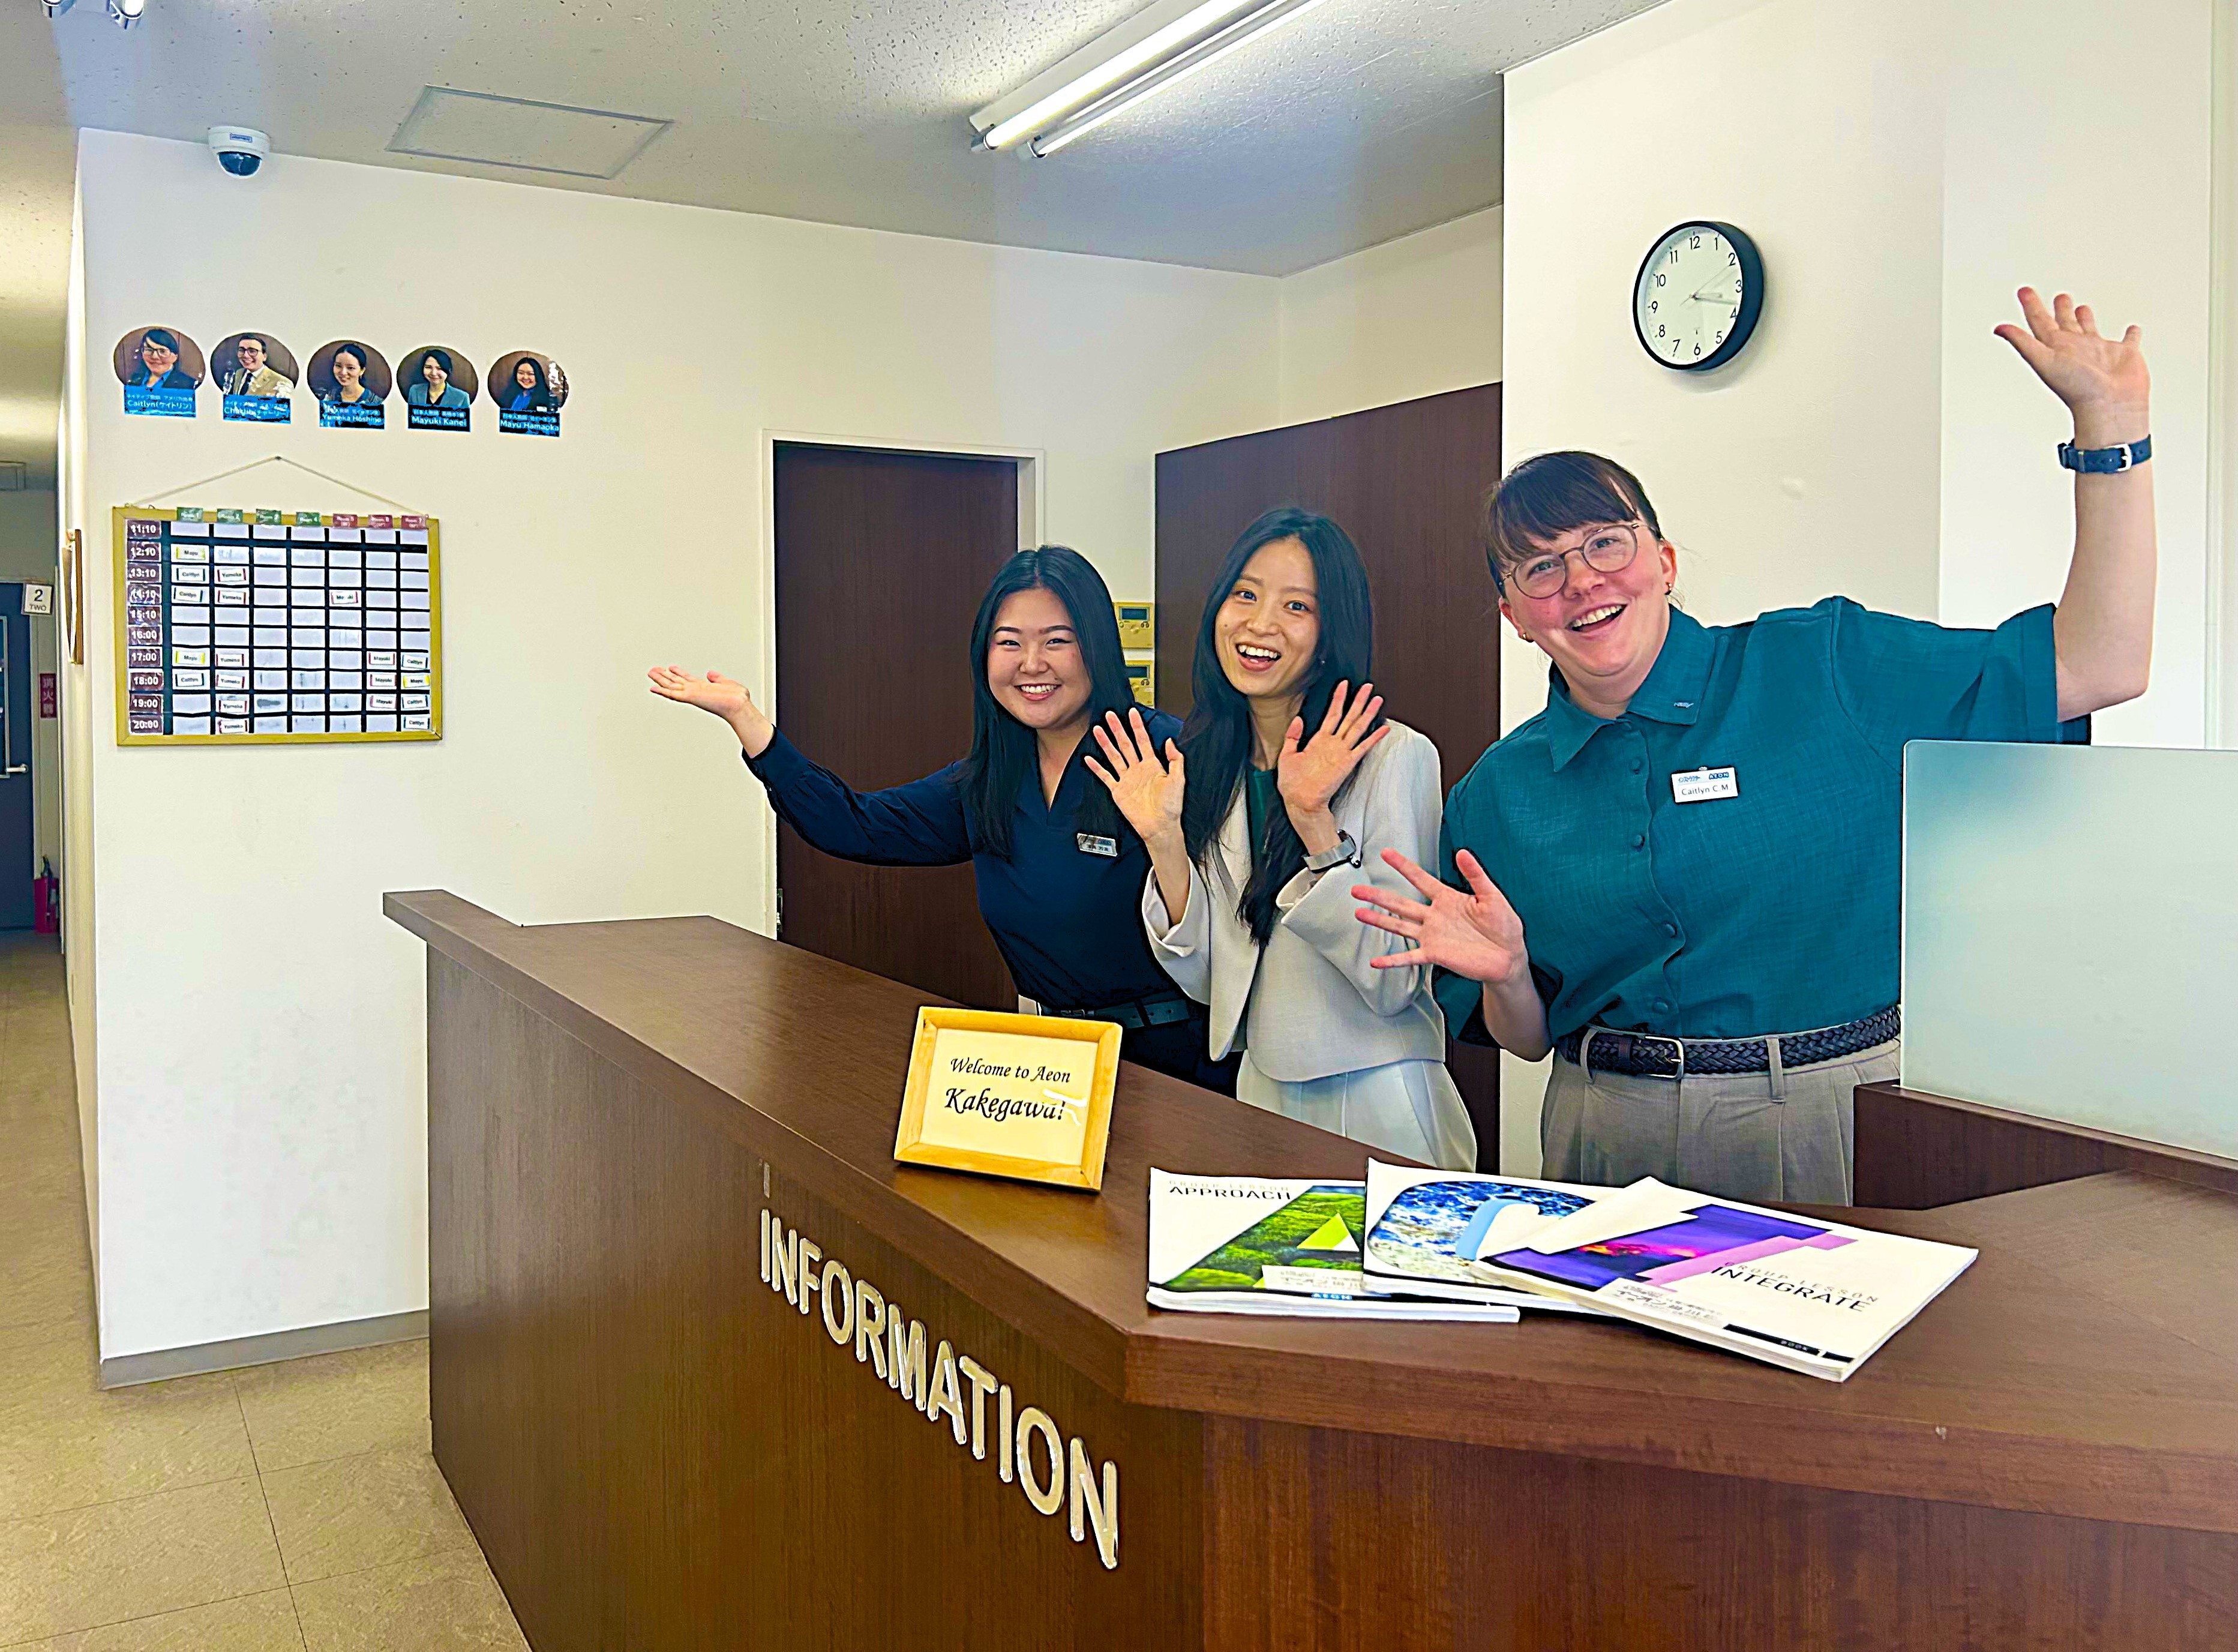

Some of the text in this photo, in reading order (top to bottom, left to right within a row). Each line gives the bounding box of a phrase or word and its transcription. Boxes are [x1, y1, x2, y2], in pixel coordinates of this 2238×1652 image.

[1689, 236, 1700, 250] 12
[1714, 237, 1718, 251] 1
[1670, 250, 1678, 264] 11
[1728, 252, 1736, 266] 2
[1655, 274, 1666, 287] 10
[1735, 280, 1742, 293] 3
[1651, 301, 1658, 313] 9
[1730, 306, 1738, 319] 4
[1658, 325, 1666, 338] 8
[1715, 331, 1723, 344] 5
[1672, 339, 1681, 353] 7
[1694, 343, 1701, 356] 6
[412, 415, 467, 427] Mayuki Kanei
[500, 419, 560, 431] Mayu Hamaoka
[130, 524, 156, 534] 11:10
[130, 547, 156, 557] 12:10
[130, 568, 156, 577] 13:10
[34, 589, 43, 601] 2
[130, 610, 157, 620] 15:10
[131, 630, 157, 640] 16:00
[131, 652, 157, 661] 17:00
[133, 676, 159, 685] 18:00
[133, 698, 158, 708] 19:00
[133, 719, 159, 729] 20:00
[1681, 787, 1710, 796] Caitlyn
[950, 1057, 1071, 1084] Welcome to Aeon
[944, 1087, 1066, 1122] Kakegawa!
[1169, 1186, 1291, 1201] APPROACH
[1711, 1266, 1871, 1312] INTEGRATE
[761, 1208, 1118, 1570] INFORMATION
